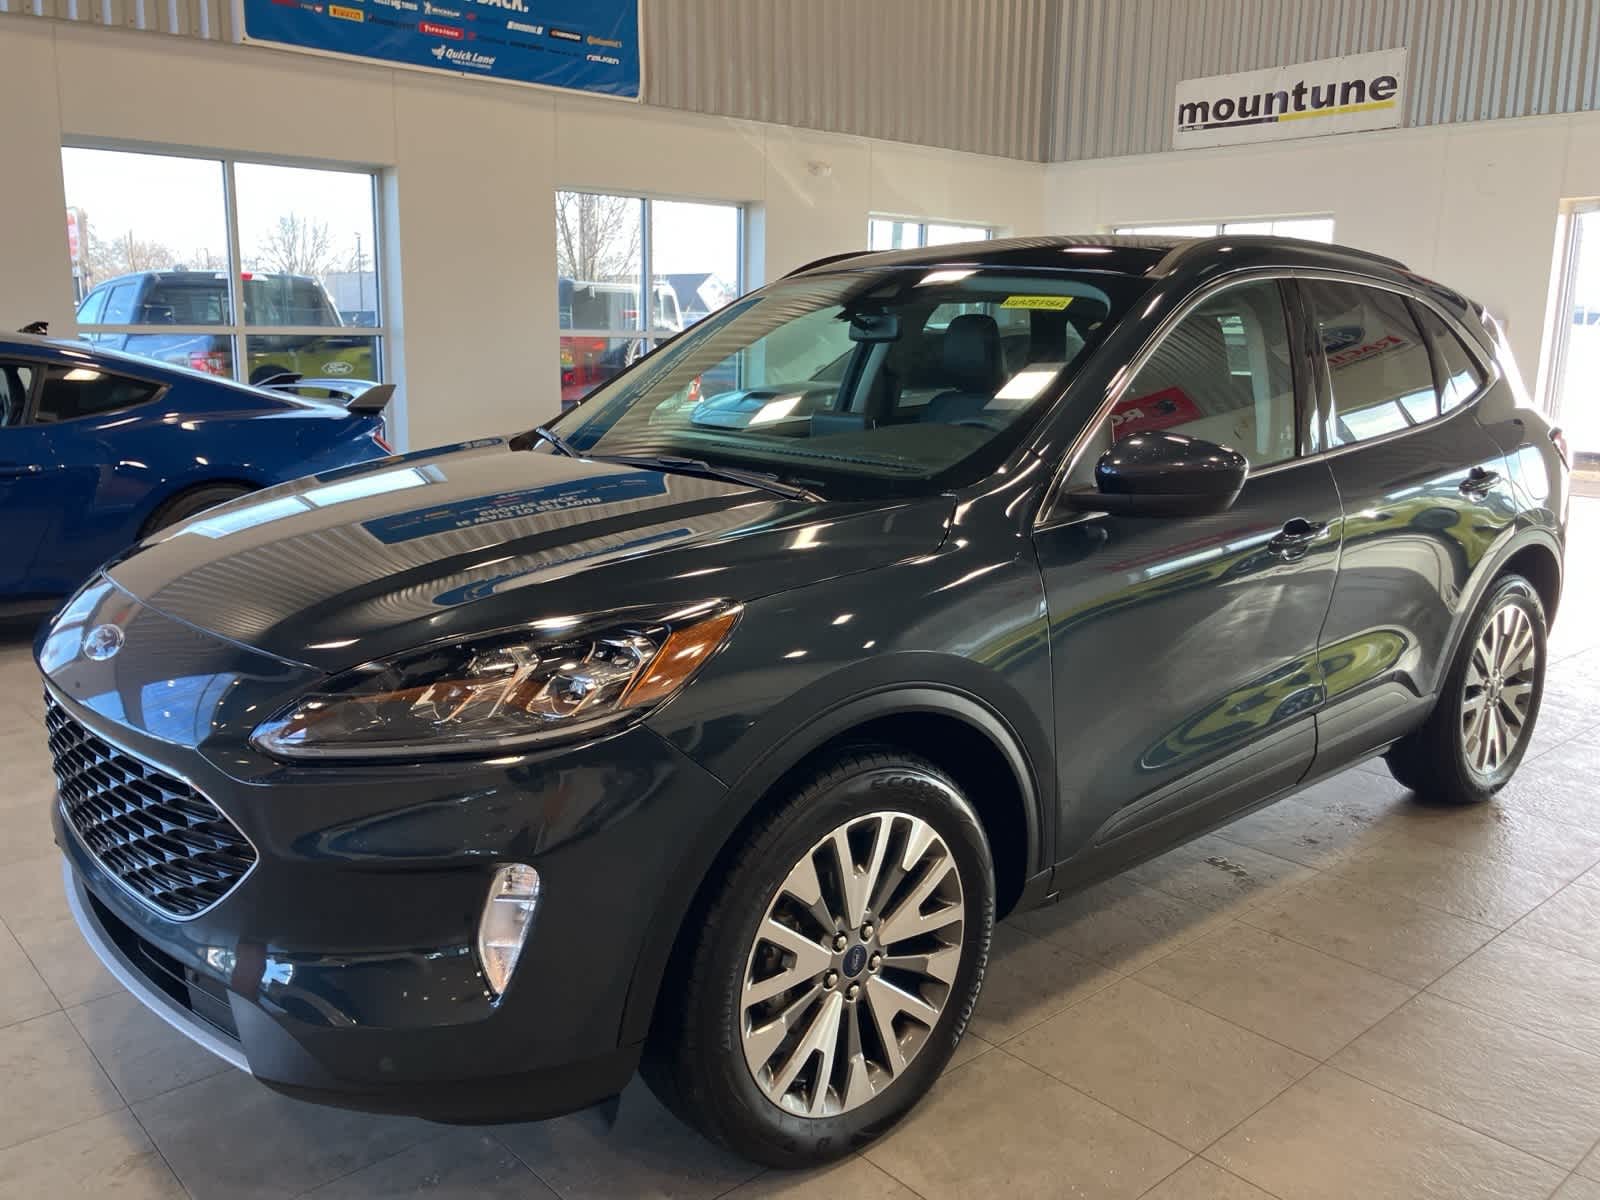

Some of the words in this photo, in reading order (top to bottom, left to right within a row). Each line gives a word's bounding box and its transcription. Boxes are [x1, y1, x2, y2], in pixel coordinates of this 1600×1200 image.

[446, 49, 472, 60] Quick
[472, 53, 497, 65] Lane
[1177, 75, 1398, 125] mountune
